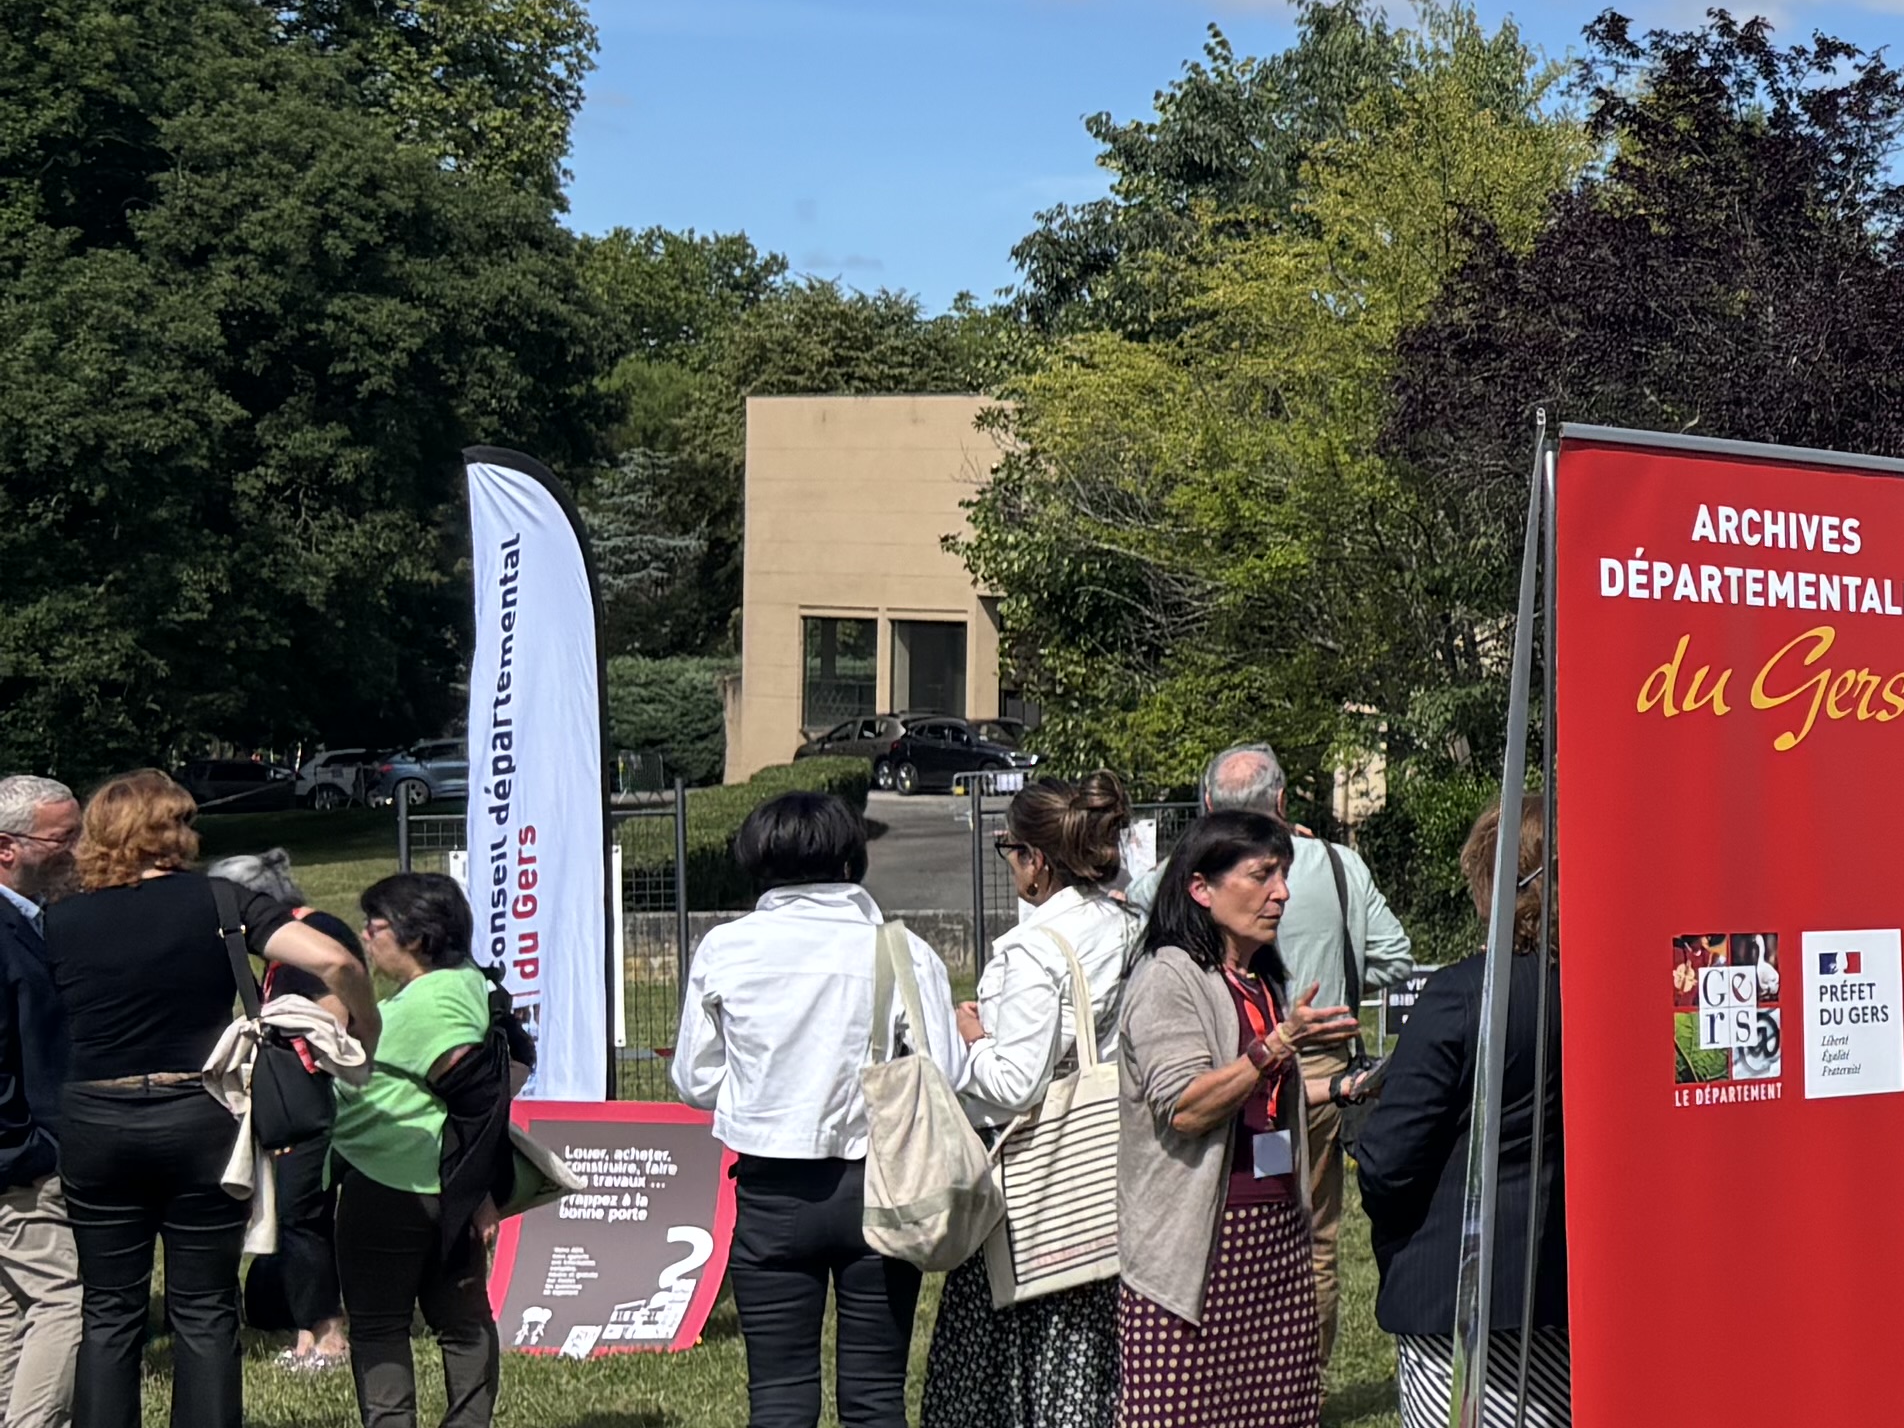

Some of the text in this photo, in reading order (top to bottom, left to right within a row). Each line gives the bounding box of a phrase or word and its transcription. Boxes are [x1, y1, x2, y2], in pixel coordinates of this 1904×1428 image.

[1691, 504, 1862, 554] ARCHIVES
[484, 532, 521, 827] départemental
[1637, 634, 1733, 717] du
[512, 824, 540, 981] du Gers
[1819, 980, 1876, 1003] PRÉFET
[1820, 1005, 1889, 1026] DU GERS
[1675, 1083, 1782, 1107] LE DÉPARTEMENT
[593, 1174, 646, 1188] travaux
[635, 1192, 648, 1207] la
[608, 1207, 648, 1223] porte
